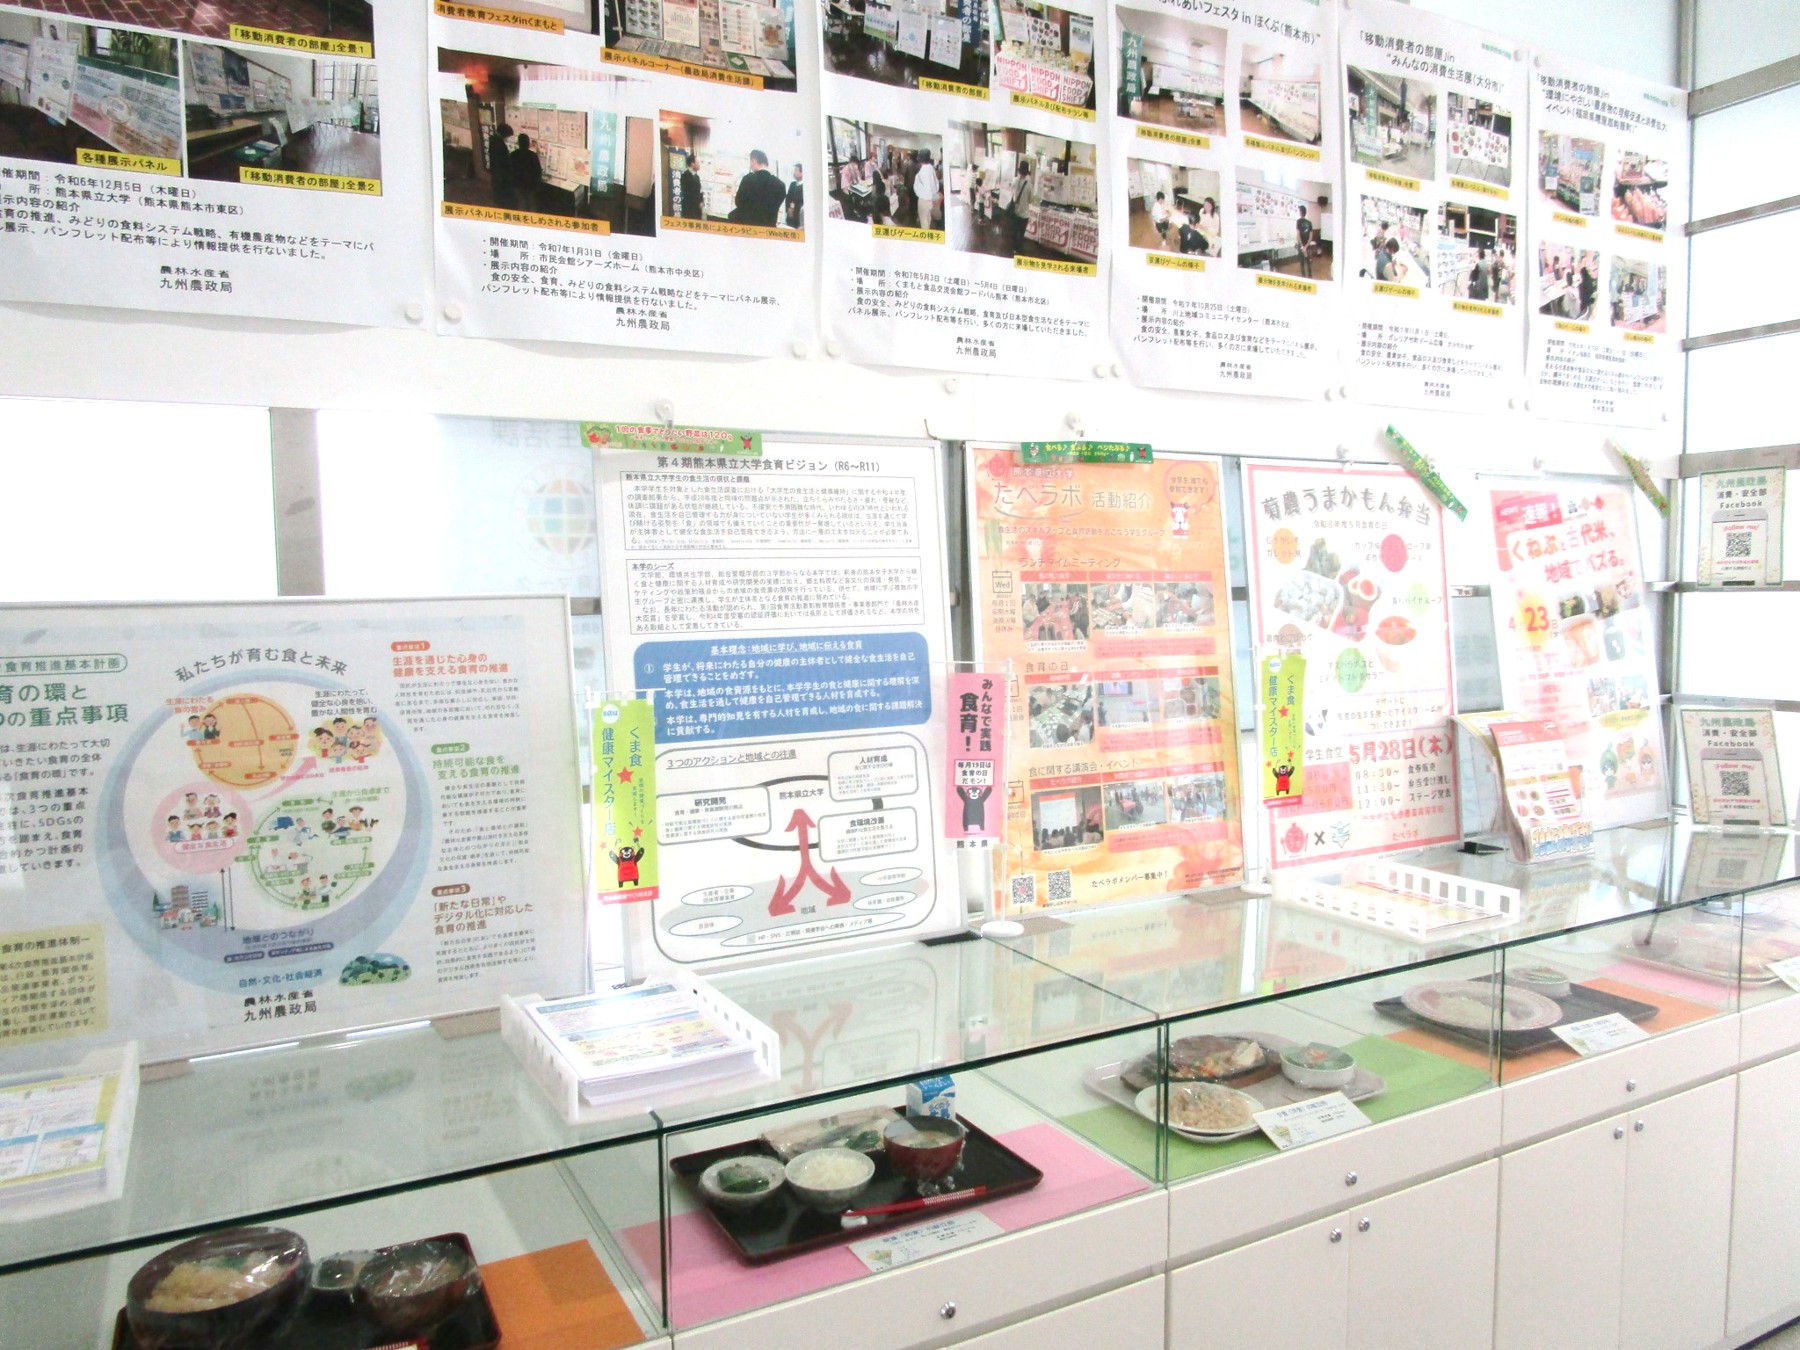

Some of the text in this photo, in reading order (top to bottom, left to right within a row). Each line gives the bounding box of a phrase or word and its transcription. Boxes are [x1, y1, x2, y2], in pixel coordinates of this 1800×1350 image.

[436, 4, 558, 31] 消費者教育フェスタinくまもと
[233, 27, 367, 55] 「移動消費者の部屋」全景1
[1031, 64, 1060, 81] NIPPON
[1063, 75, 1091, 89] NIPPON
[1061, 94, 1084, 104] SHIFT
[1062, 86, 1082, 97] FOOD
[82, 152, 168, 171] 各種展示パネル
[243, 169, 375, 193] 「移動消費者の部屋」全景2
[0, 195, 81, 213] 示内容の紹介
[160, 265, 230, 279] 農林水産省
[160, 278, 233, 294] 九州農政局
[615, 306, 669, 319] 農林水産省
[615, 318, 671, 332] 九州農政局
[956, 346, 997, 358] 九州農政局
[994, 482, 1152, 510] たべラボ 活動紹介
[1261, 485, 1432, 526] 菊農うまかもん弁当
[1720, 500, 1763, 509] Facebook
[631, 562, 675, 571] 本学のシーズ
[1020, 557, 1120, 569] ランチタイムミーティング
[994, 581, 1010, 589] Wed
[1524, 606, 1550, 632] 23
[174, 647, 349, 683] 私たちが育む食と未来
[392, 653, 488, 667] 生涯を通じた心身の
[1025, 661, 1069, 673] 食育の日
[393, 663, 509, 677] 健康を支える食育の推進
[664, 670, 759, 684] 管理できることをめざす。
[0, 703, 129, 727] の重点事項
[959, 691, 979, 752] 食育！
[979, 678, 994, 752] みんなで実践
[667, 724, 716, 737] に貢献する。
[629, 726, 643, 767] くま食
[1305, 746, 1343, 761] 学生食堂
[432, 754, 505, 770] 持続可能な食を
[859, 754, 888, 765] 人材育成
[957, 761, 992, 769] 毎月19日は
[1028, 758, 1138, 776] 食に関する講演会・イベント
[437, 764, 521, 781] 支える食育の推進
[961, 769, 988, 777] 食育の日
[601, 727, 616, 836] 健康マイスター店
[694, 796, 727, 807] 研究開発
[778, 788, 825, 800] 熊本県立大学
[849, 816, 885, 828] 食環境改善
[956, 839, 988, 849] 熊本県
[1091, 869, 1168, 888] たべラボメンバー募集中！
[434, 895, 507, 912] 「新たな日常」や
[800, 905, 816, 915] 地域
[434, 903, 534, 923] デジタル化に対応した
[434, 919, 488, 935] 食育の推進
[238, 968, 323, 988] 自然・文化・社会経済
[244, 989, 314, 1007] 農林水産省
[244, 1000, 318, 1023] 九州農政局
